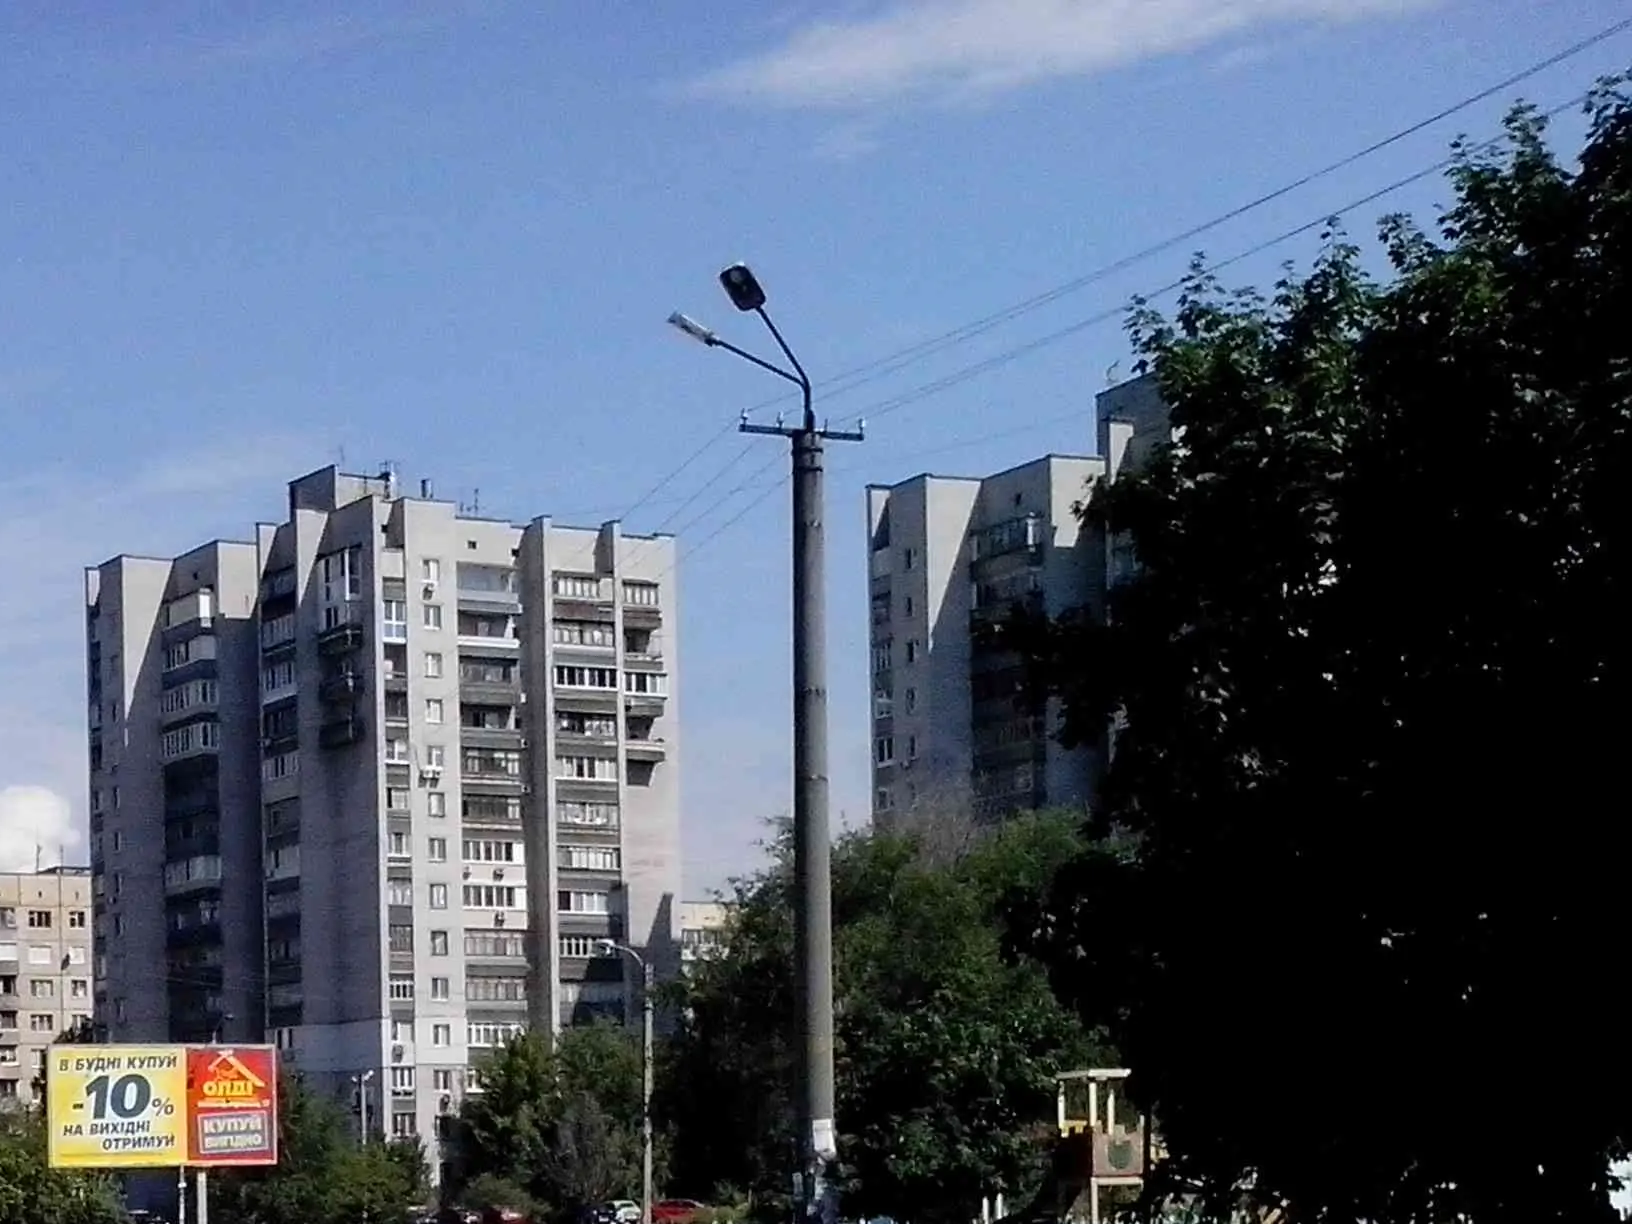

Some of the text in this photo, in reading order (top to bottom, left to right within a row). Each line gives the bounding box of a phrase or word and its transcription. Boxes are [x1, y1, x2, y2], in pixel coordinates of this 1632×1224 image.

[59, 1054, 178, 1072] В БУДНІ КУПУЙ
[63, 1120, 151, 1137] НА ВИХІДНІ
[102, 1134, 175, 1151] ОТРИМУЙ
